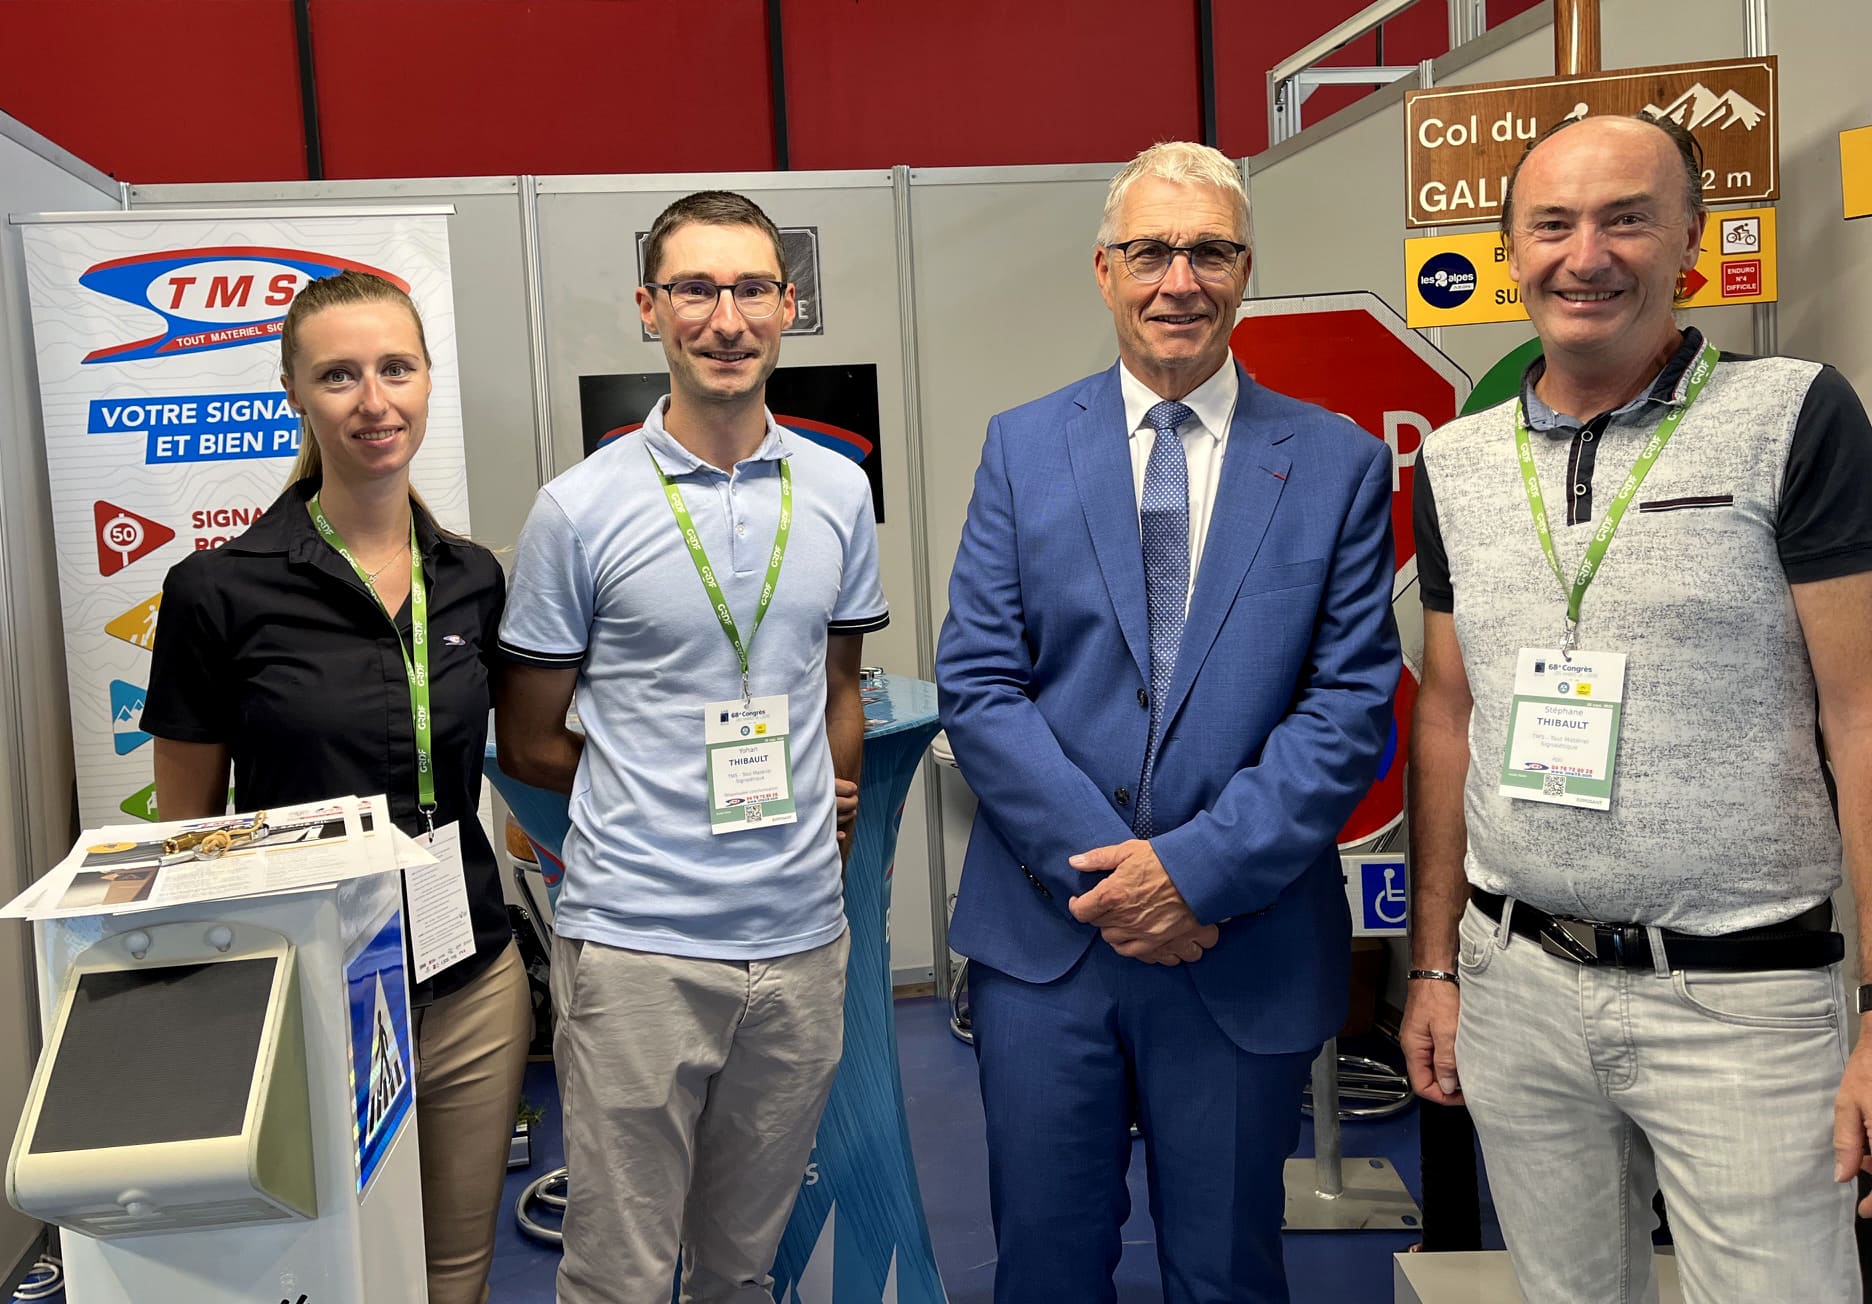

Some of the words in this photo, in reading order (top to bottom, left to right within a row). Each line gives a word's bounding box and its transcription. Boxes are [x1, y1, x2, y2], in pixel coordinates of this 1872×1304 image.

[1418, 115, 1477, 149] Col
[1491, 112, 1537, 142] du
[1727, 171, 1752, 188] m
[1448, 273, 1474, 284] alpes
[1727, 267, 1755, 275] ENDURO
[168, 274, 297, 309] TMS
[1726, 283, 1757, 291] DIFFICILE
[176, 336, 206, 347] TOUT
[211, 327, 262, 342] MATERIEL
[1690, 358, 1710, 385] GRDF
[101, 403, 198, 428] VOTRE
[156, 435, 191, 457] ET
[199, 432, 263, 455] BIEN
[1642, 434, 1662, 460] GRDF
[1617, 474, 1637, 500] GRDF
[112, 527, 136, 542] 50
[317, 515, 335, 535] GRDF
[1596, 515, 1614, 542] GRDF
[686, 527, 702, 551] GRDF
[701, 565, 718, 589] GRDF
[1576, 558, 1594, 586] GRDF
[413, 582, 424, 604] GRDF
[761, 583, 773, 606] GRDF
[717, 602, 733, 626] GRDF
[413, 619, 424, 645] GRDF
[415, 661, 425, 687] GRDF
[1562, 664, 1593, 674] Congrès
[417, 704, 427, 730] GRDF
[741, 709, 766, 718] Congrès
[1544, 705, 1584, 716] Stéphane
[1536, 717, 1589, 730] THIBAULT
[417, 748, 428, 773] GRDF
[728, 755, 769, 767] THIBAULT
